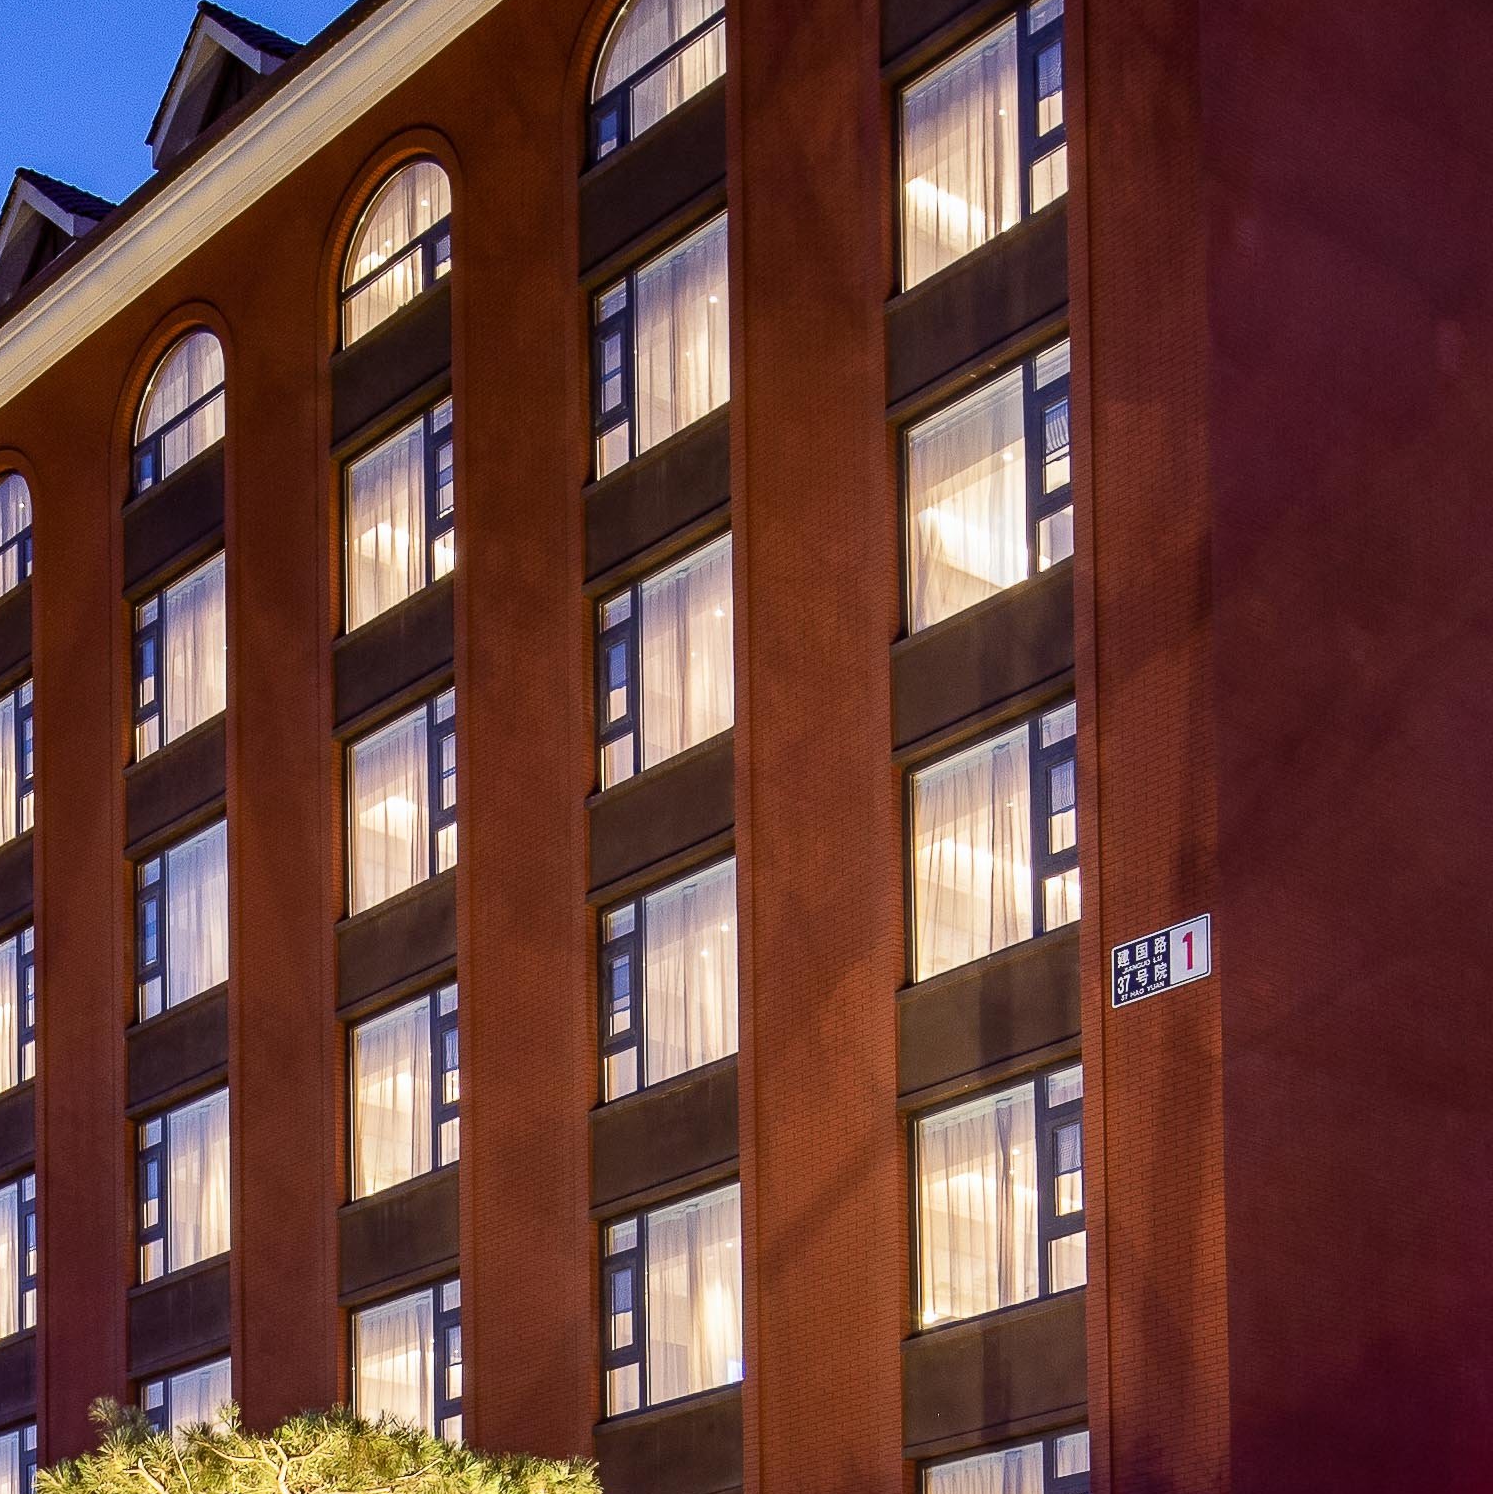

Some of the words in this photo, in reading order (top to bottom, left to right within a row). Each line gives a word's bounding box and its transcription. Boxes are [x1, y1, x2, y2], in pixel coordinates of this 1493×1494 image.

[1117, 936, 1167, 969] 建国路
[1182, 931, 1193, 971] 1
[1117, 962, 1168, 995] 37号院
[1147, 980, 1165, 992] YUAN
